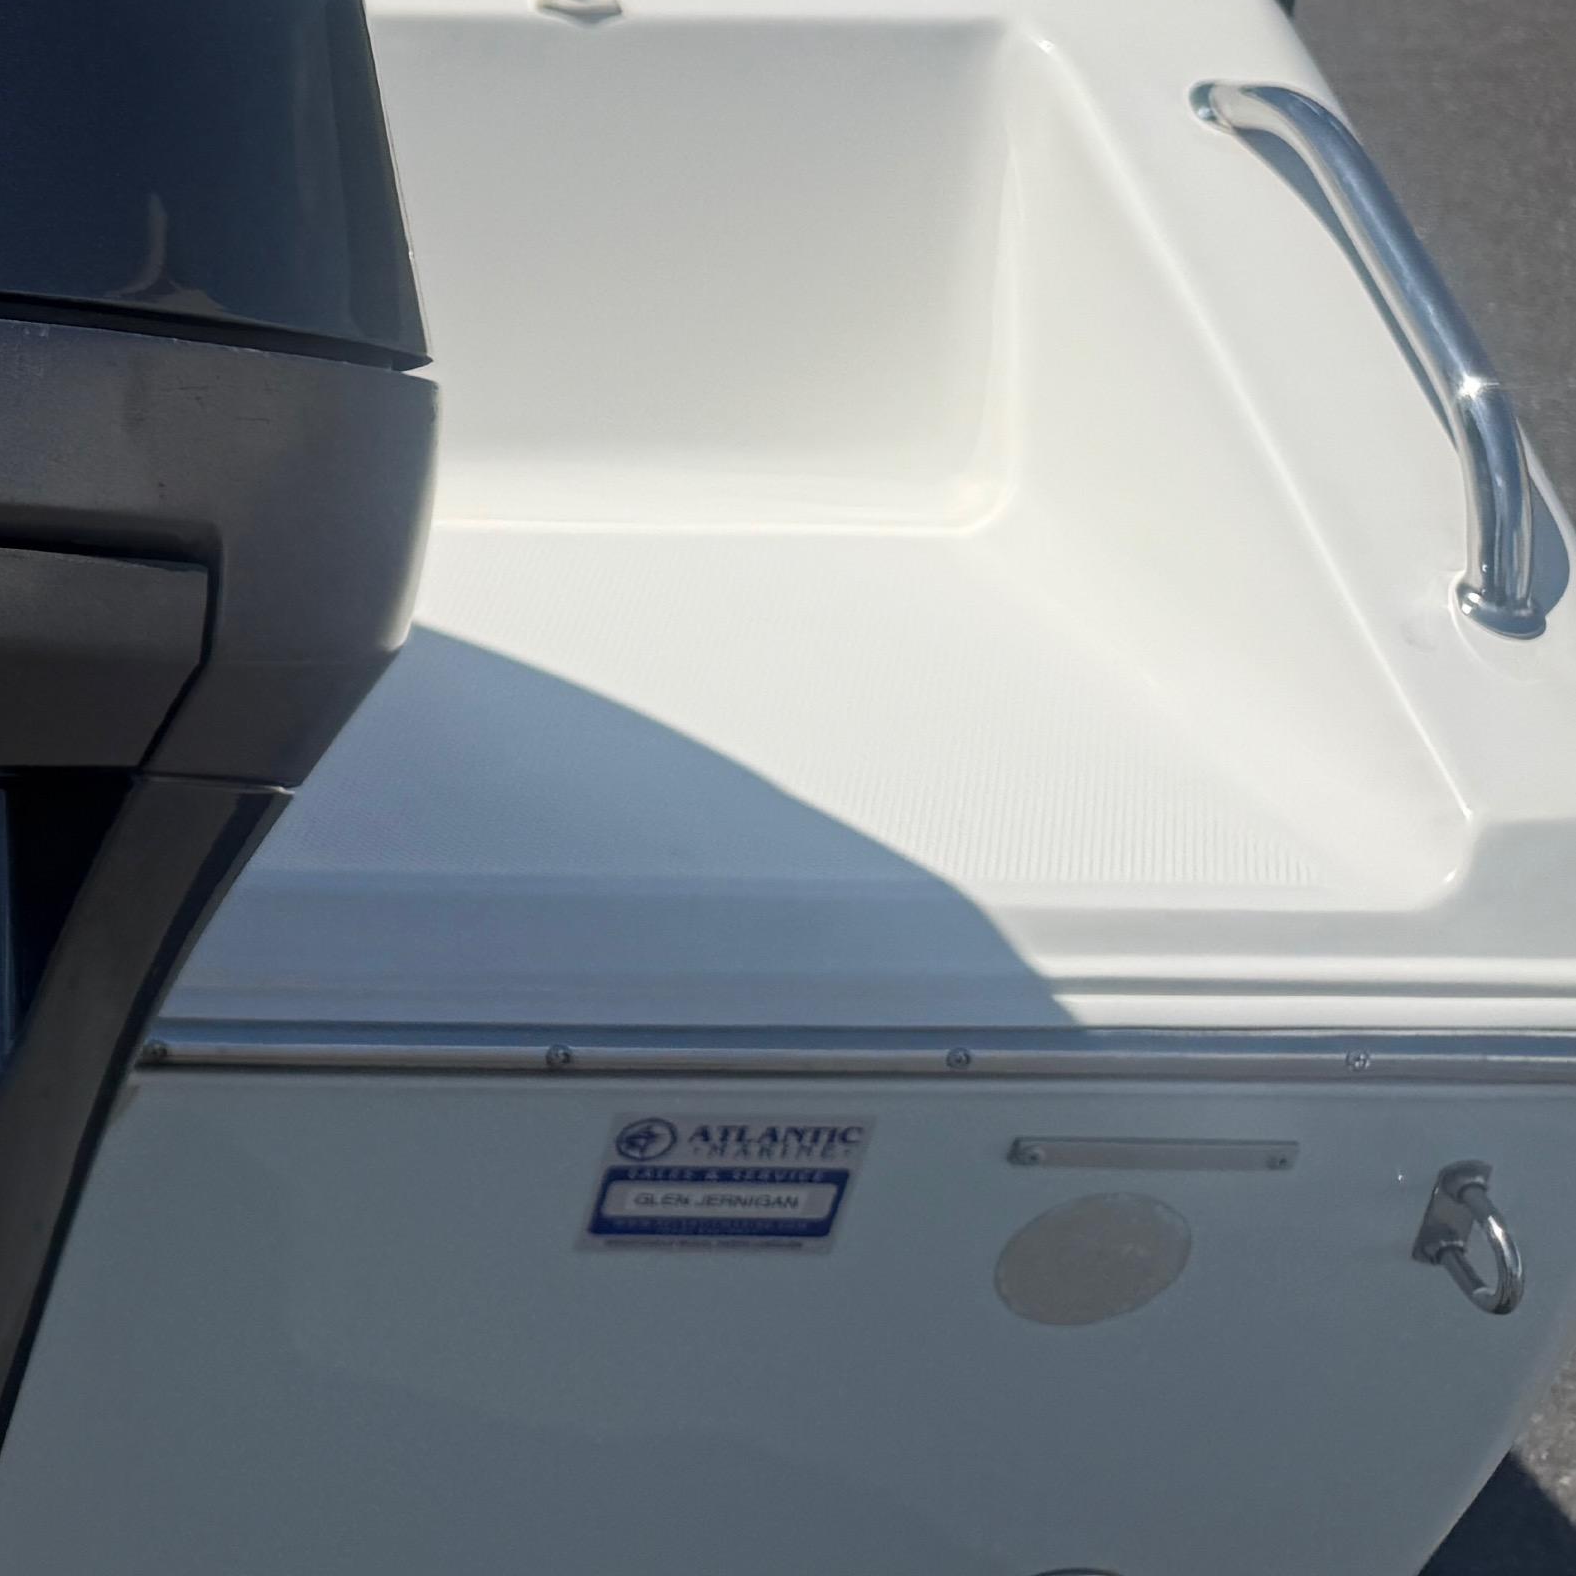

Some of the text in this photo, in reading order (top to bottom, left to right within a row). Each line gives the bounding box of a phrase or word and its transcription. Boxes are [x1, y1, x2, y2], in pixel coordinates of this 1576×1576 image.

[687, 1124, 864, 1143] ATLANTIC
[633, 1192, 800, 1209] GLEN JERNIGAN
